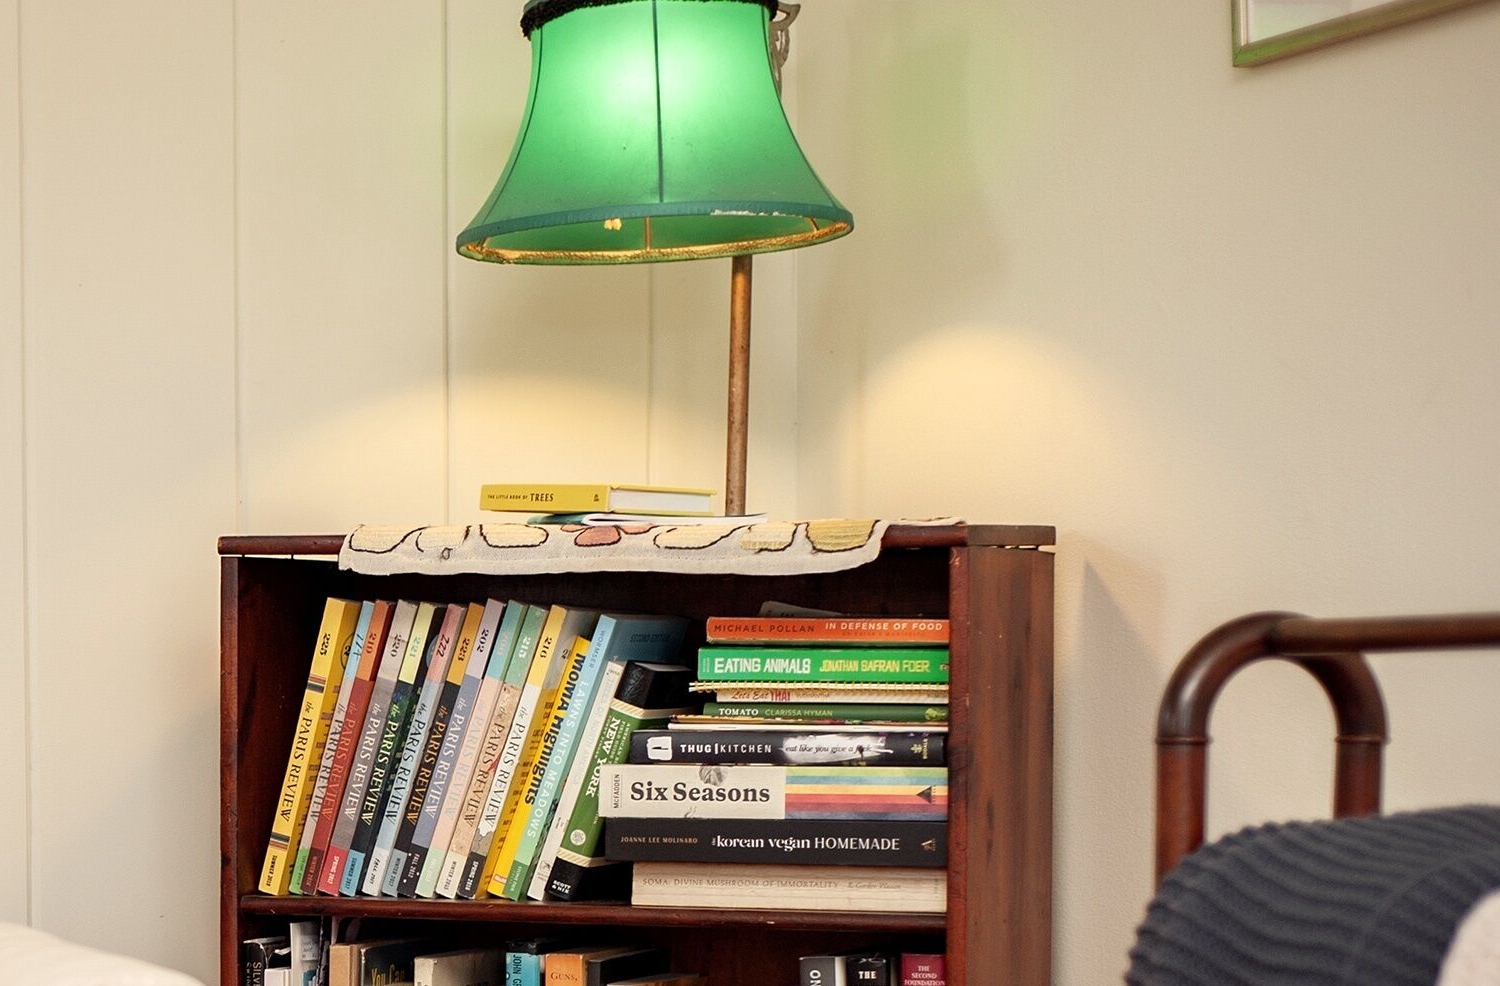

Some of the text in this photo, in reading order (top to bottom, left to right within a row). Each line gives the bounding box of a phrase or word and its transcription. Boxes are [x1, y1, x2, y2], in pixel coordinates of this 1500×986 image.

[530, 493, 554, 502] TREES
[714, 624, 815, 632] MICHAEL POLLAN
[825, 622, 943, 631] IN DEFENSE OF FOOD
[436, 633, 450, 658] 222
[476, 628, 490, 653] 202
[539, 637, 553, 660] 216
[714, 657, 811, 674] EATING ANIMALS
[819, 660, 930, 672] JONATHAN SAFRAN FOER
[718, 708, 759, 716] TOMATO
[765, 708, 833, 717] CLARISSA HYMAN
[602, 717, 622, 755] NEW
[680, 743, 772, 754] THUG KITCHEN
[280, 701, 313, 822] the PARIS REVIEW
[344, 703, 381, 821] the PARIS REVIEW
[362, 703, 400, 826] the PARIS REVIEW
[406, 705, 448, 826] the PARIS REVIEW
[527, 681, 590, 839] LAWNS INTO MEADOWS
[613, 773, 621, 809] MCFADDEN
[630, 781, 771, 803] Six Seasons
[620, 836, 698, 844] JOANNE LEE MOLINARO
[716, 834, 900, 852] korean vegan HOMEMADE
[512, 954, 522, 974] JOHN
[550, 971, 579, 982] GUNS,
[858, 971, 876, 979] THE
